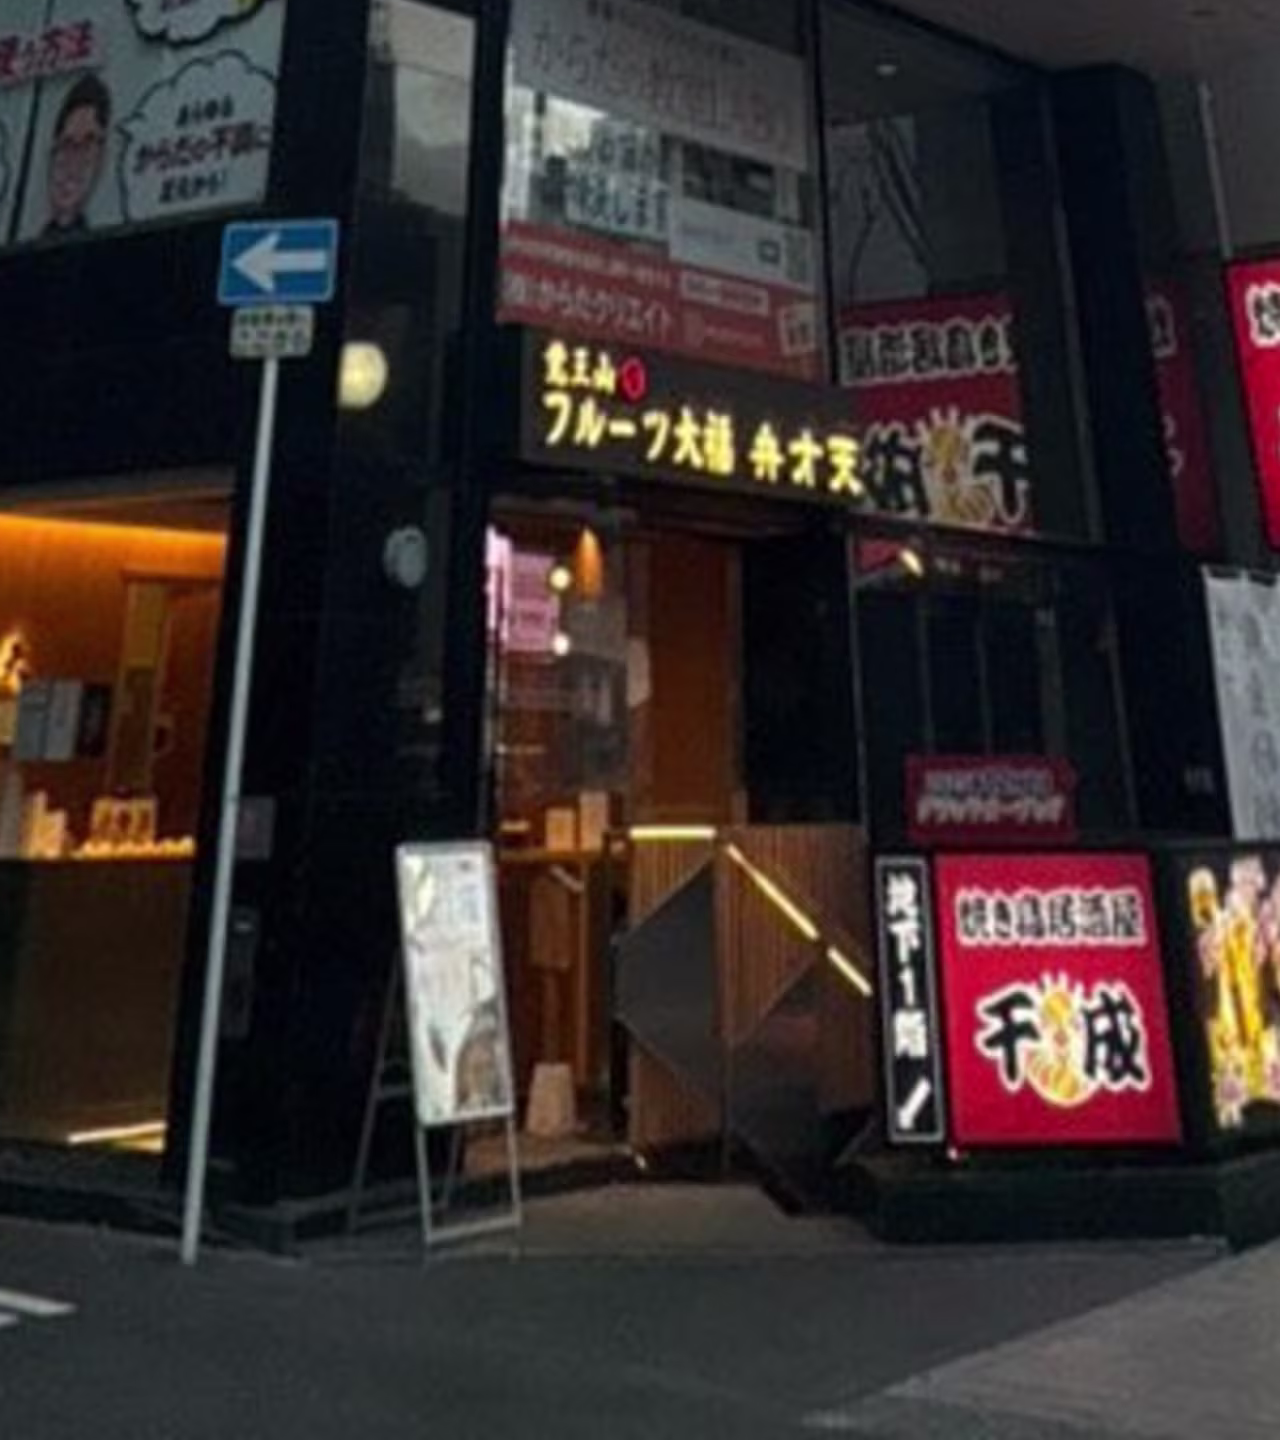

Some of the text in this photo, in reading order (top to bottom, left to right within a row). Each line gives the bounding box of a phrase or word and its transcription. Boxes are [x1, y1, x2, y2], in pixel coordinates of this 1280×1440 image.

[542, 390, 735, 476] フルーツ大福
[955, 887, 1146, 947] 焼き鳥居酒屋
[976, 980, 1152, 1092] 千成
